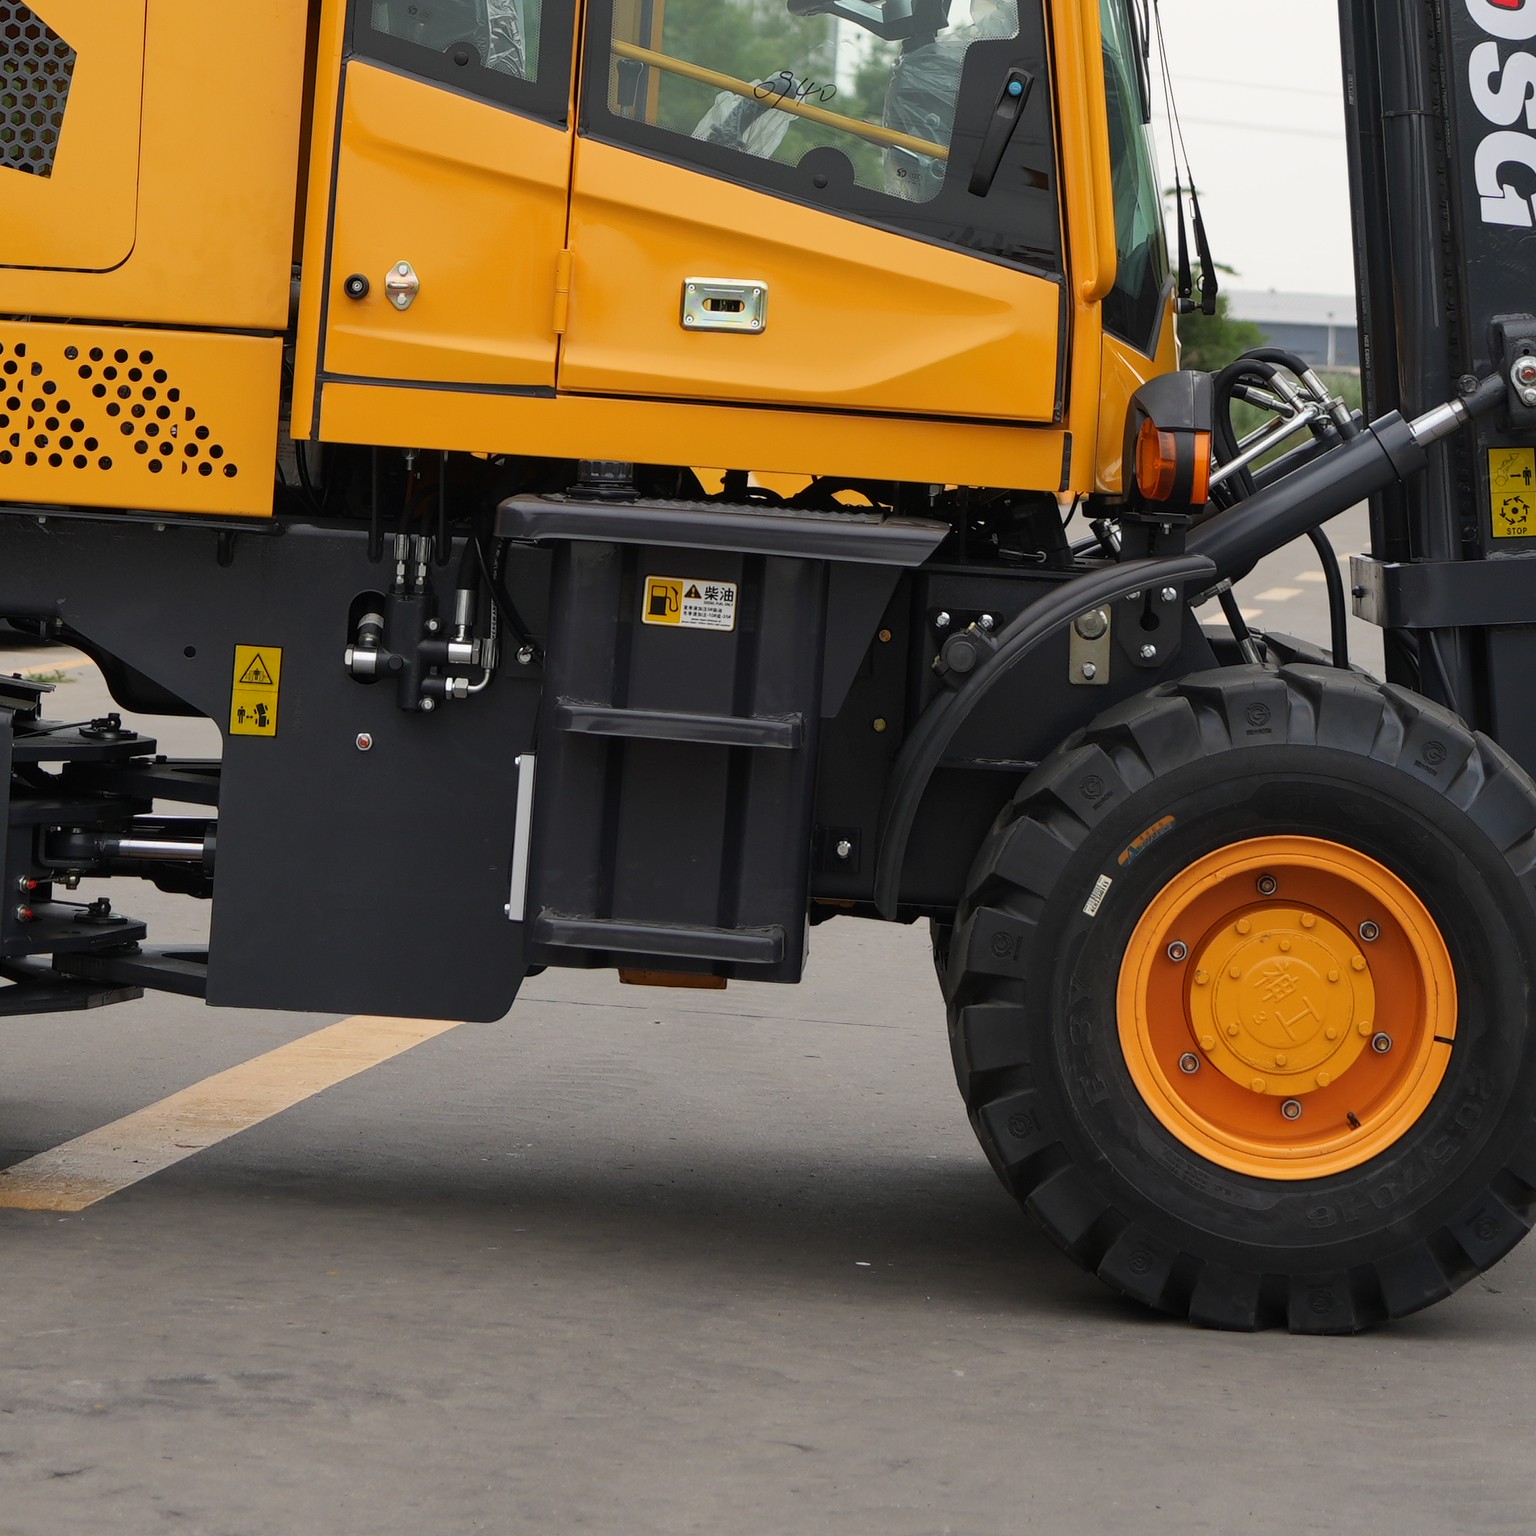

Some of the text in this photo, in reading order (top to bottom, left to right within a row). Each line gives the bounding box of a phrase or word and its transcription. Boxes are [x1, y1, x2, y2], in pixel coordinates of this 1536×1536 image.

[753, 70, 838, 109] 0940
[1506, 527, 1528, 535] STOP
[704, 585, 734, 602] 柴油
[1253, 962, 1321, 1042] 神工
